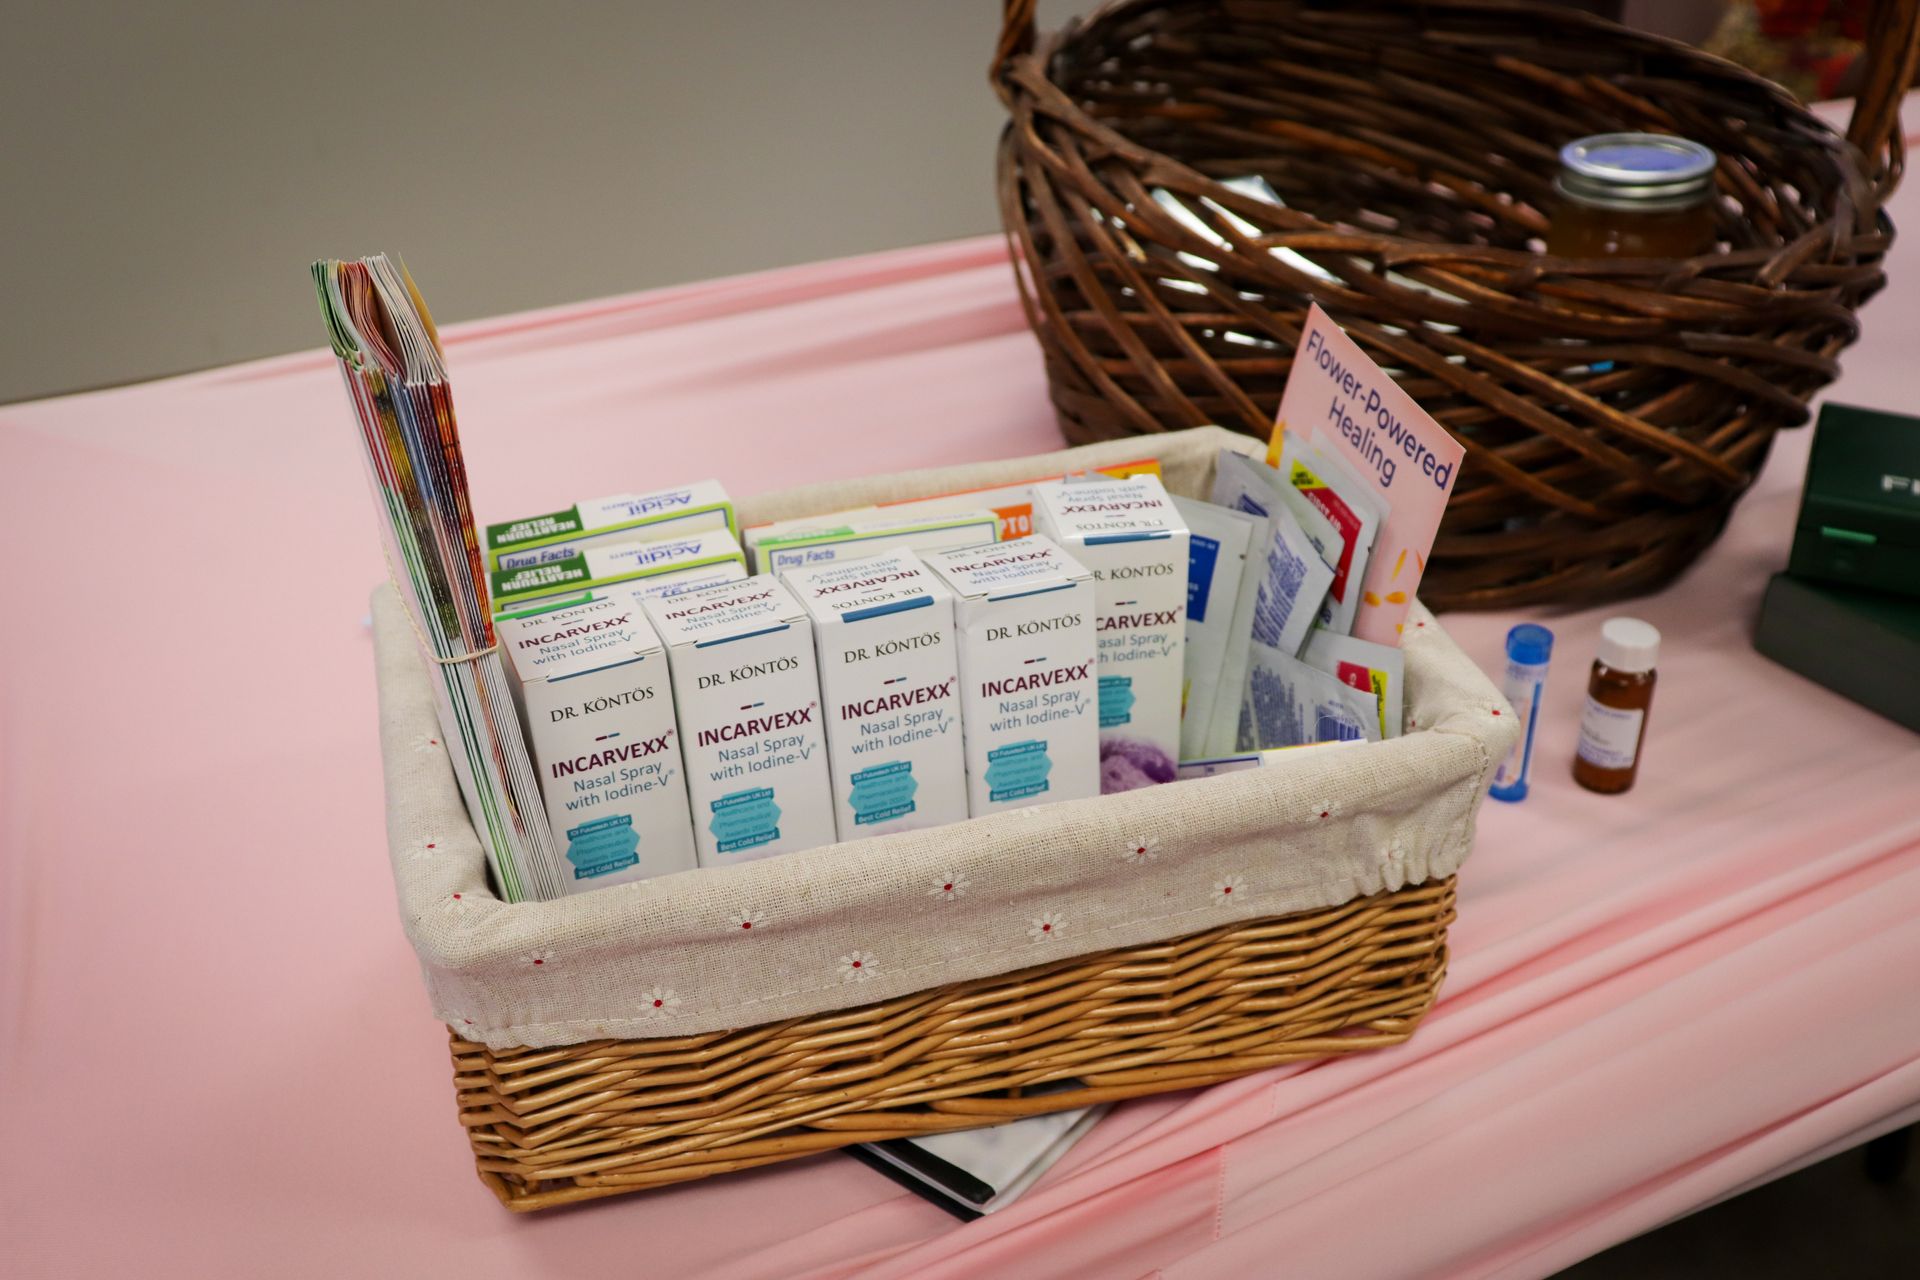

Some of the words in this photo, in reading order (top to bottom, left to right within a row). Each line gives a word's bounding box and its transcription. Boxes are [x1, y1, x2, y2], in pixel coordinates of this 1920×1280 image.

[1306, 329, 1453, 491] Flower-Powered
[1328, 396, 1396, 488] Healing
[497, 520, 576, 543] HEARTBURN
[510, 517, 555, 532] RELIEF
[540, 548, 575, 564] Facts
[778, 553, 803, 567] Drug
[806, 550, 835, 562] Facts
[502, 568, 583, 591] HEARTBURN
[516, 564, 561, 580] RELIEF
[686, 609, 725, 624] Nasal
[729, 602, 769, 615] Spray
[680, 620, 713, 632] with
[986, 626, 1012, 642] DR.
[1017, 613, 1081, 637] KÖNTÖS
[540, 636, 582, 655] Nasal
[585, 628, 624, 645] Spray
[844, 647, 871, 664] DR.
[875, 631, 941, 656] KÖNTÖS
[1097, 635, 1126, 649] asal
[1130, 633, 1168, 648] Spray
[533, 650, 567, 666] with
[698, 673, 725, 690] DR.
[730, 658, 799, 682] KÖNTÖS
[551, 706, 579, 723] DR.
[584, 686, 654, 714] KÖNTÖS
[999, 694, 1038, 714] Nasal
[1041, 690, 1081, 708] Spray
[860, 714, 900, 736] Nasal
[904, 708, 943, 729] Spray
[990, 713, 1022, 733] with
[718, 741, 760, 763] Nasal
[764, 734, 805, 755] Spray
[851, 734, 884, 754] with
[574, 770, 616, 793] Nasal
[621, 761, 662, 782] Spray
[710, 762, 744, 782] with
[565, 791, 601, 811] with
[858, 814, 873, 822] Best
[874, 810, 890, 818] Cold
[720, 842, 735, 850] Best
[737, 837, 753, 846] Cold
[578, 868, 594, 876] Best
[596, 863, 612, 872] Cold
[613, 857, 634, 867] Relief
